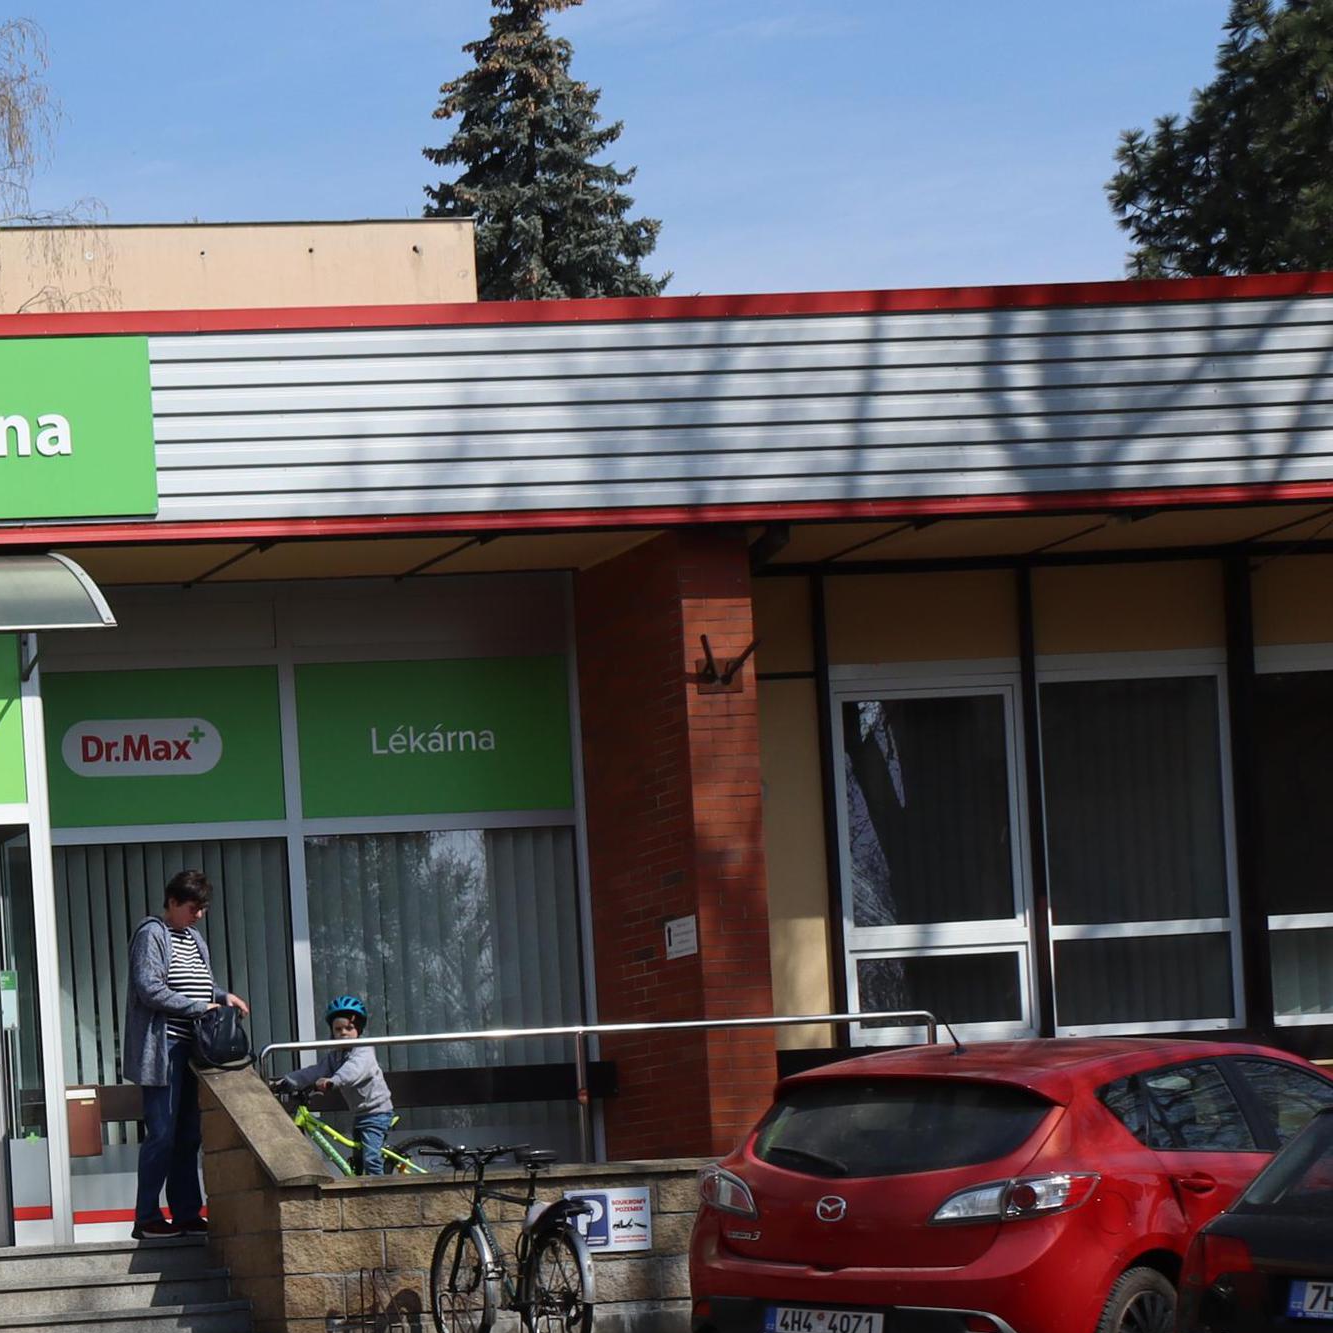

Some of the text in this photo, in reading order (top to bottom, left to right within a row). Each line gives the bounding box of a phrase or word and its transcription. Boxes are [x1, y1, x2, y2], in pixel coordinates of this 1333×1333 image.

[81, 733, 193, 763] Dr.Max
[370, 724, 496, 754] Lékárna
[779, 1310, 813, 1333] 4H4
